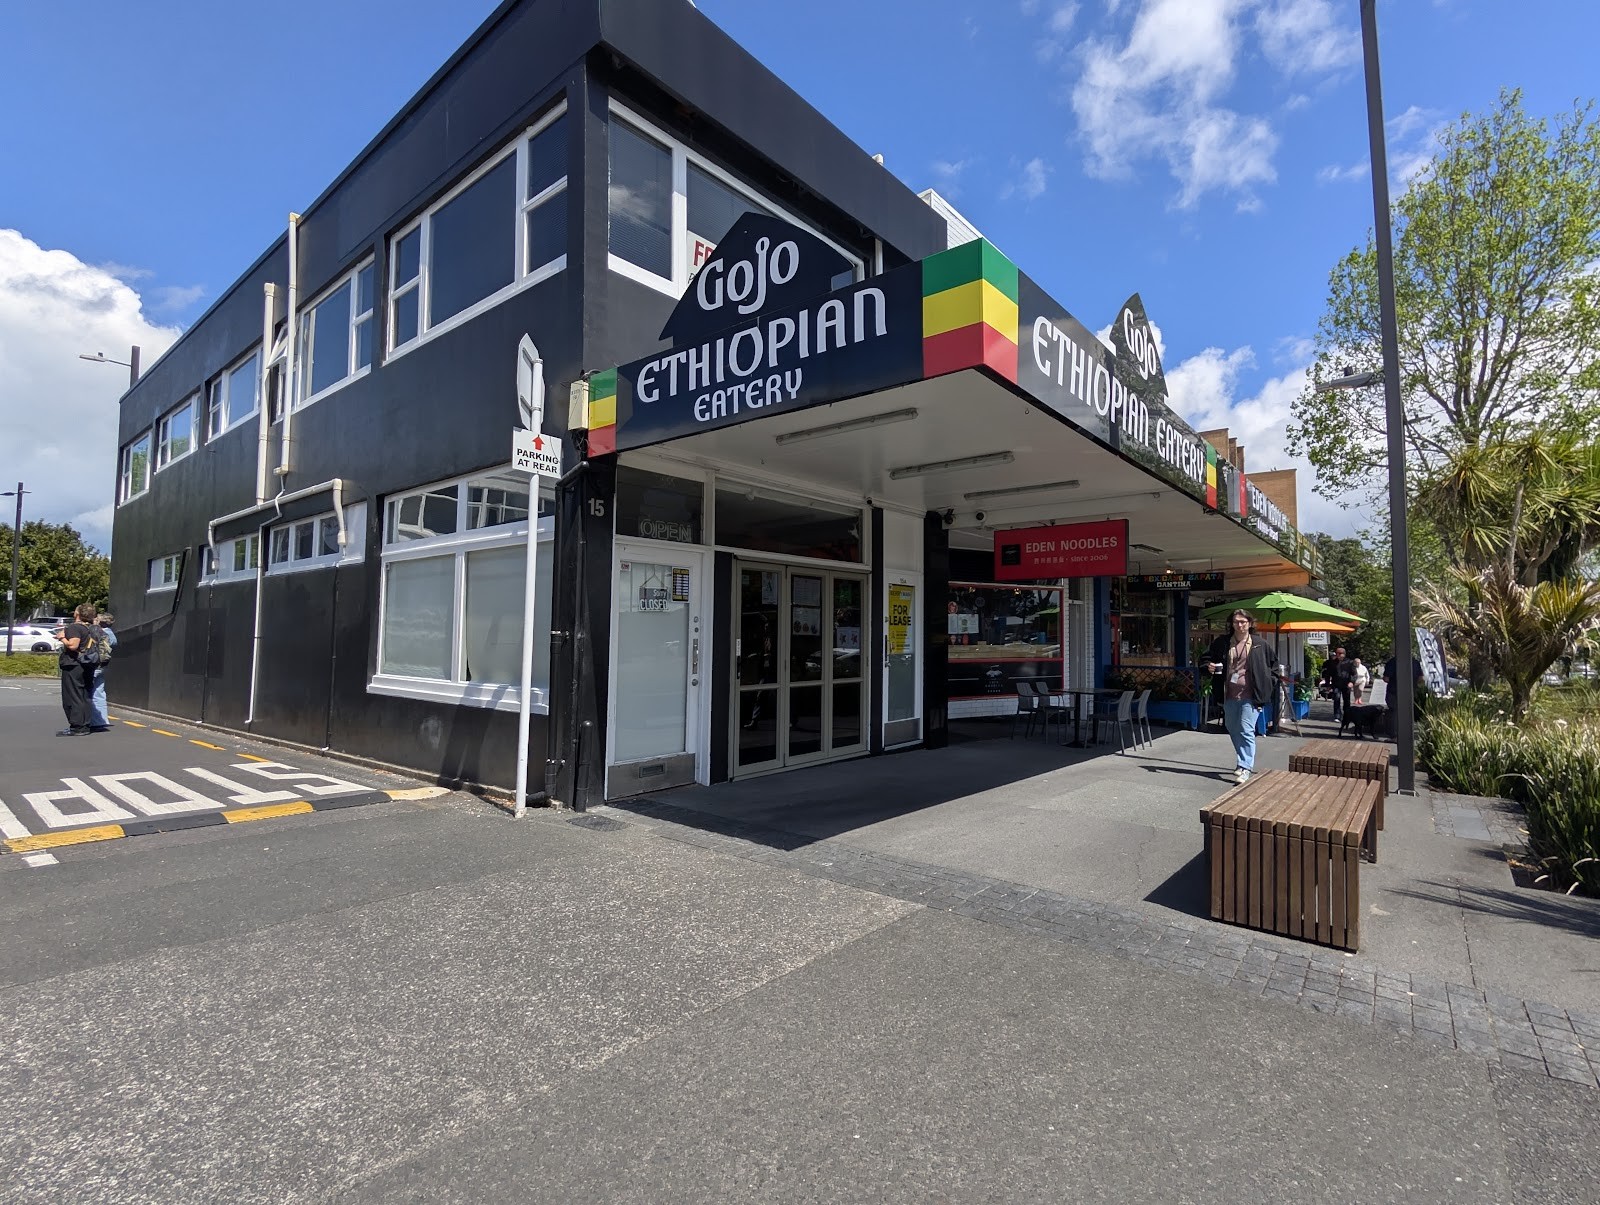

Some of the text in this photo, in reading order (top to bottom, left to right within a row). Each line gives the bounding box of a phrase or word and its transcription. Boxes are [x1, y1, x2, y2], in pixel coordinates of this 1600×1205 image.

[637, 288, 887, 403] ETHIOPIAN
[694, 368, 803, 422] EATERY
[1032, 316, 1204, 483] ETHIOPIAN EATERY
[517, 448, 560, 465] PARKING
[517, 459, 558, 474] AT REAR
[588, 498, 605, 517] 15
[640, 518, 692, 543] OPEN
[1025, 537, 1118, 553] EDEN NOODLES
[1070, 555, 1089, 563] since
[639, 599, 668, 611] CLOSED
[893, 605, 908, 615] FOR
[889, 616, 912, 626] LEASE
[22, 762, 377, 828] STOP
